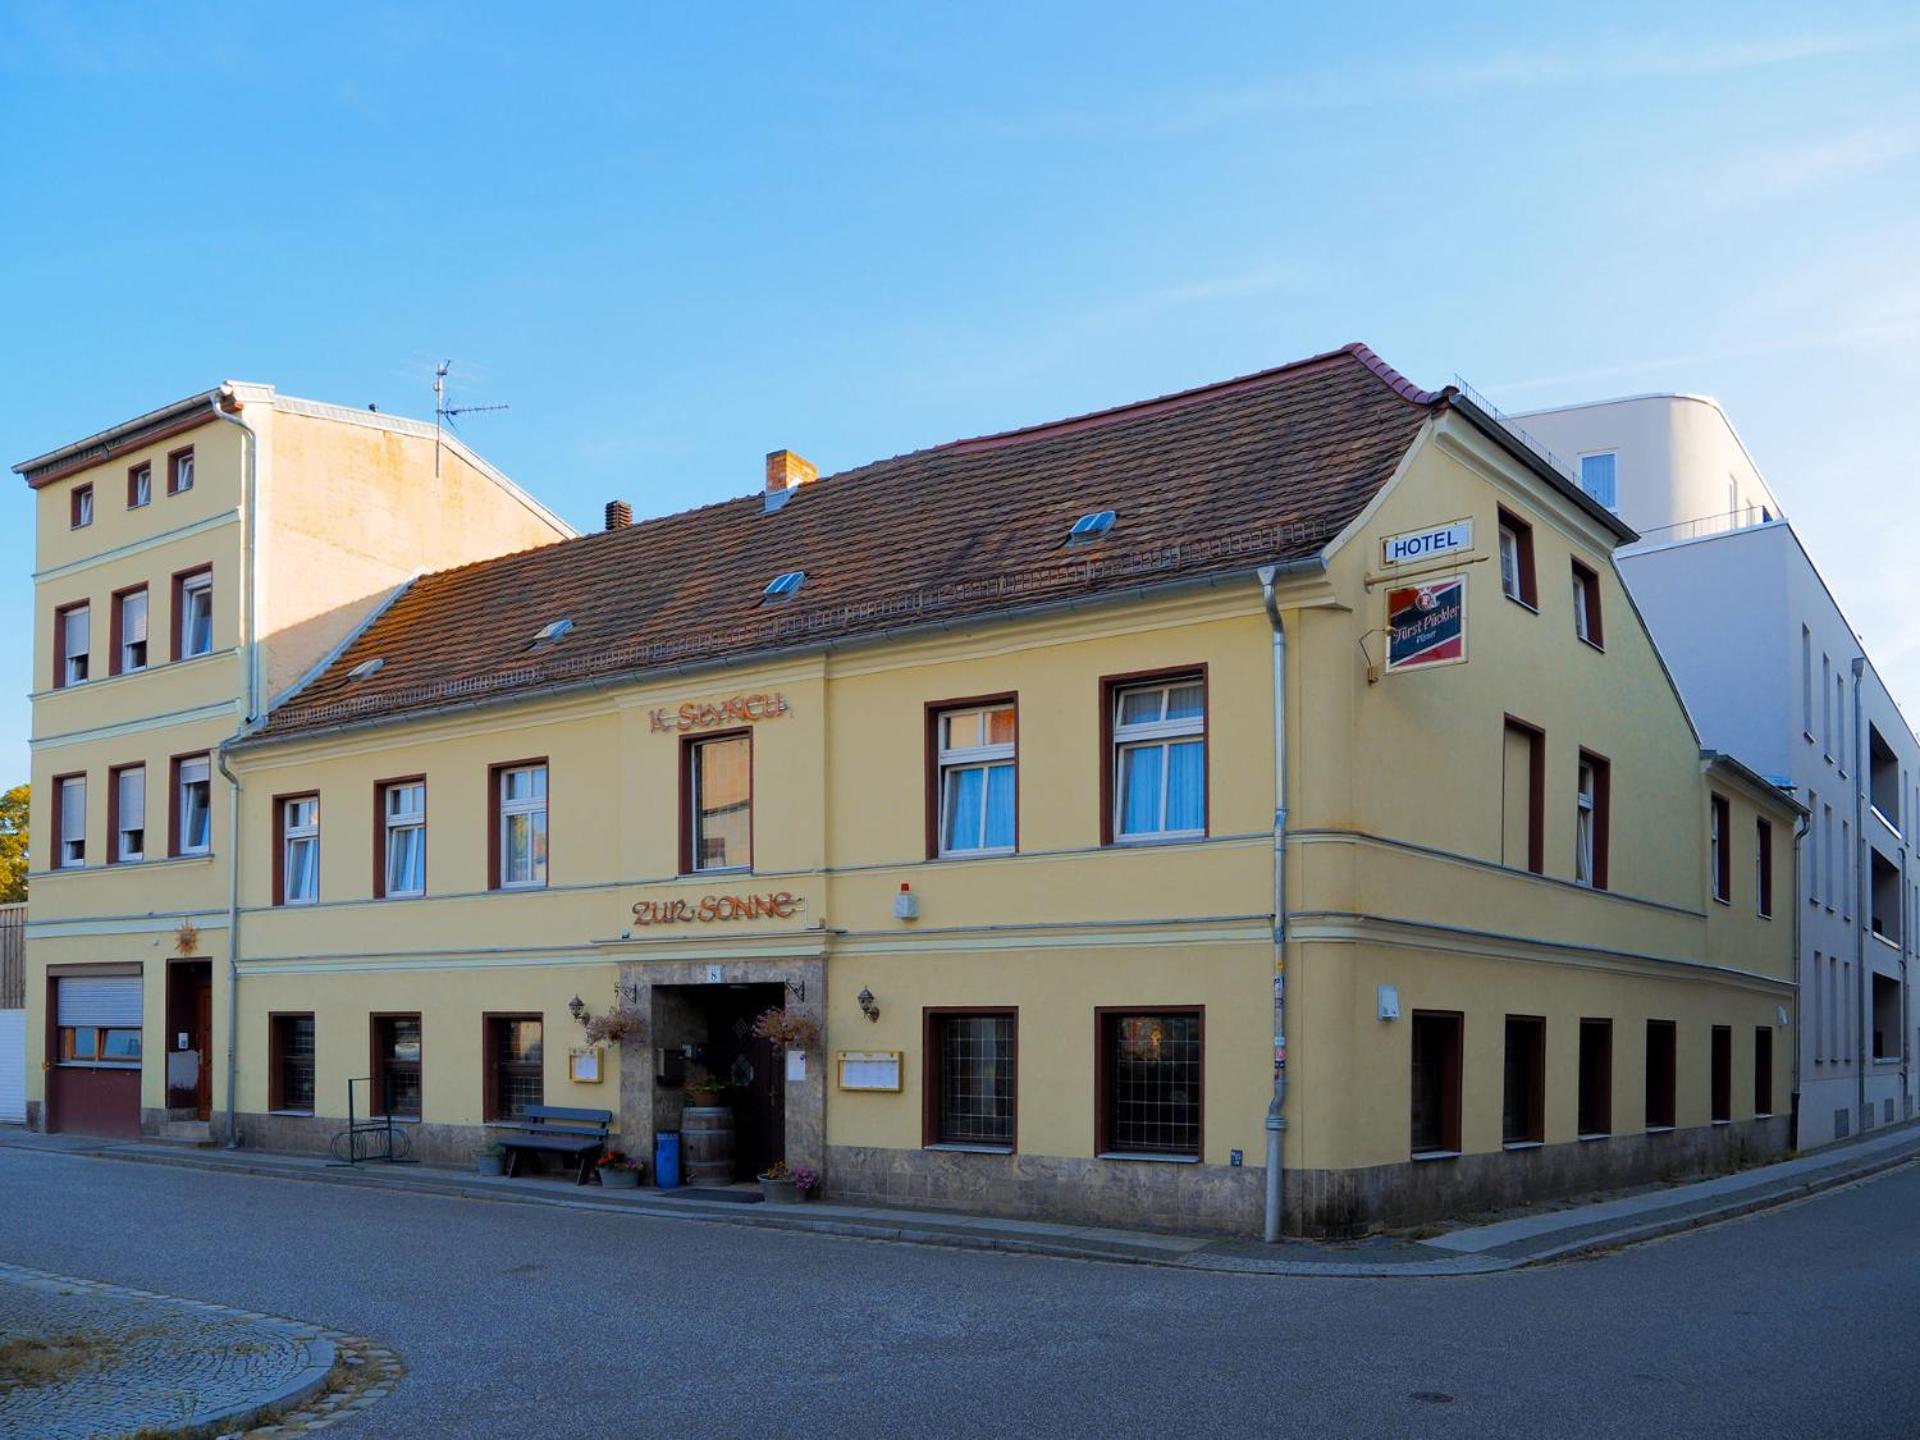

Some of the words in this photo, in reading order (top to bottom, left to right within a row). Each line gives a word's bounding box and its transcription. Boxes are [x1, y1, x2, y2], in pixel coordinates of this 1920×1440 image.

[1394, 530, 1458, 558] HOTEL
[1392, 620, 1422, 644] Fürst
[1424, 605, 1460, 630] Pückler
[632, 898, 695, 926] ZUR
[698, 891, 797, 923] SONNE
